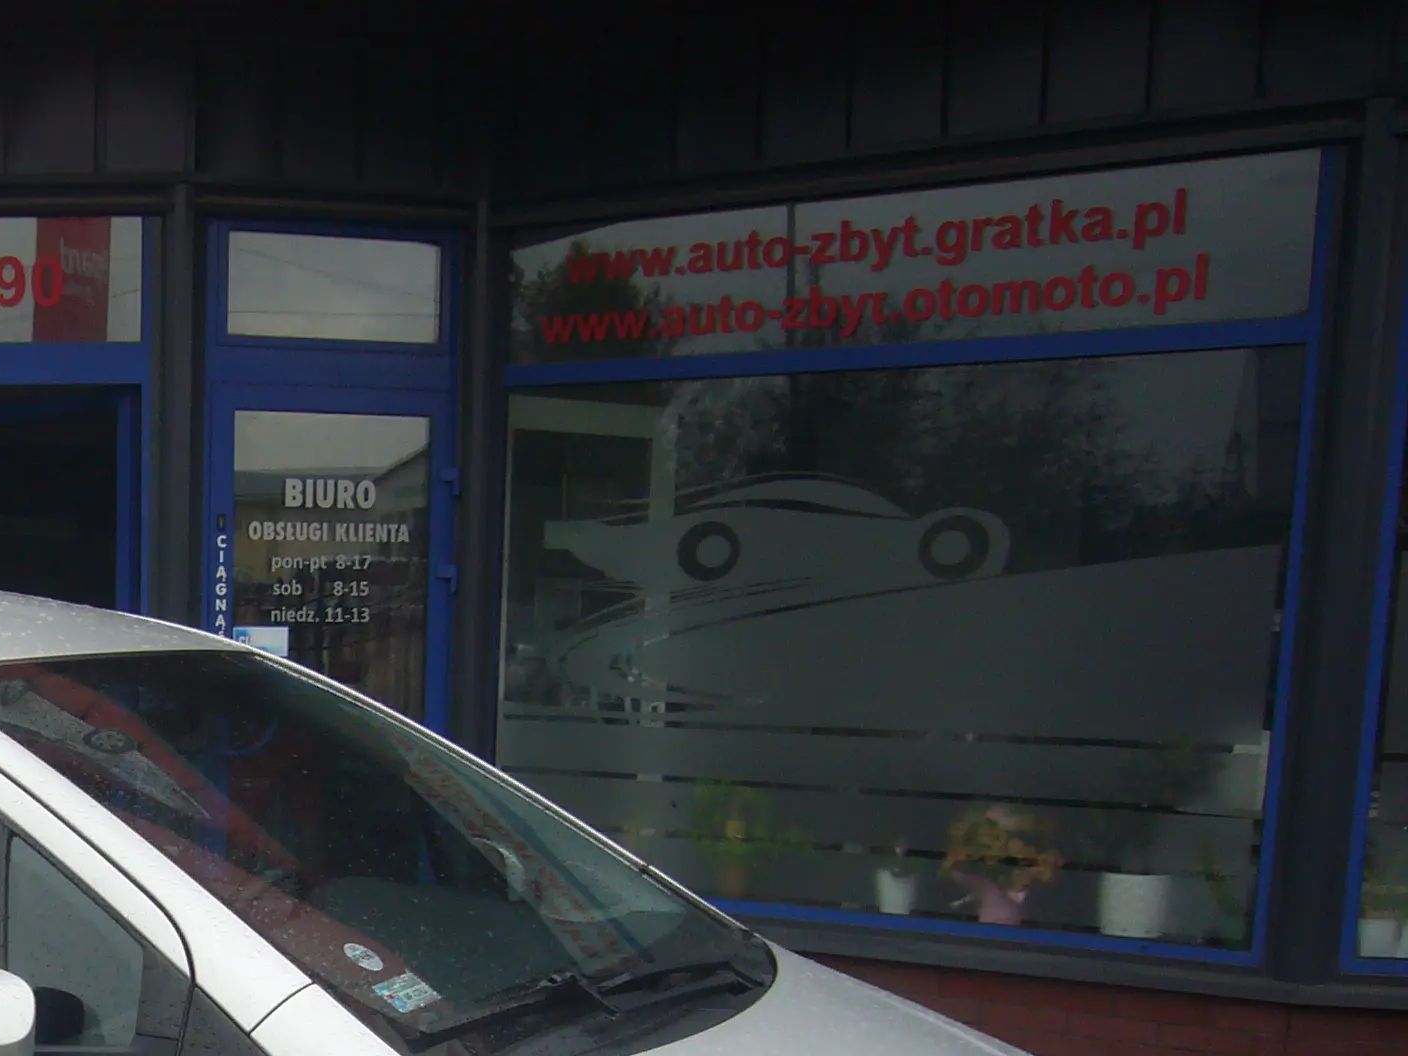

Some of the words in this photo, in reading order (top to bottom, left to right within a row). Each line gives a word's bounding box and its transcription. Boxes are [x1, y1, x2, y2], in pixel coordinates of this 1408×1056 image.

[566, 188, 1188, 285] www.auto-zbyt.gratka.pl
[284, 478, 376, 509] BIURO
[248, 520, 328, 542] OBSŁUGI
[335, 523, 410, 543] KLIENTA
[271, 555, 328, 573] pon-pt
[335, 554, 372, 570] 8-17
[272, 580, 303, 596] sob
[333, 581, 370, 597] 8-15
[270, 606, 321, 623] niedz.
[325, 607, 370, 623] 11-13
